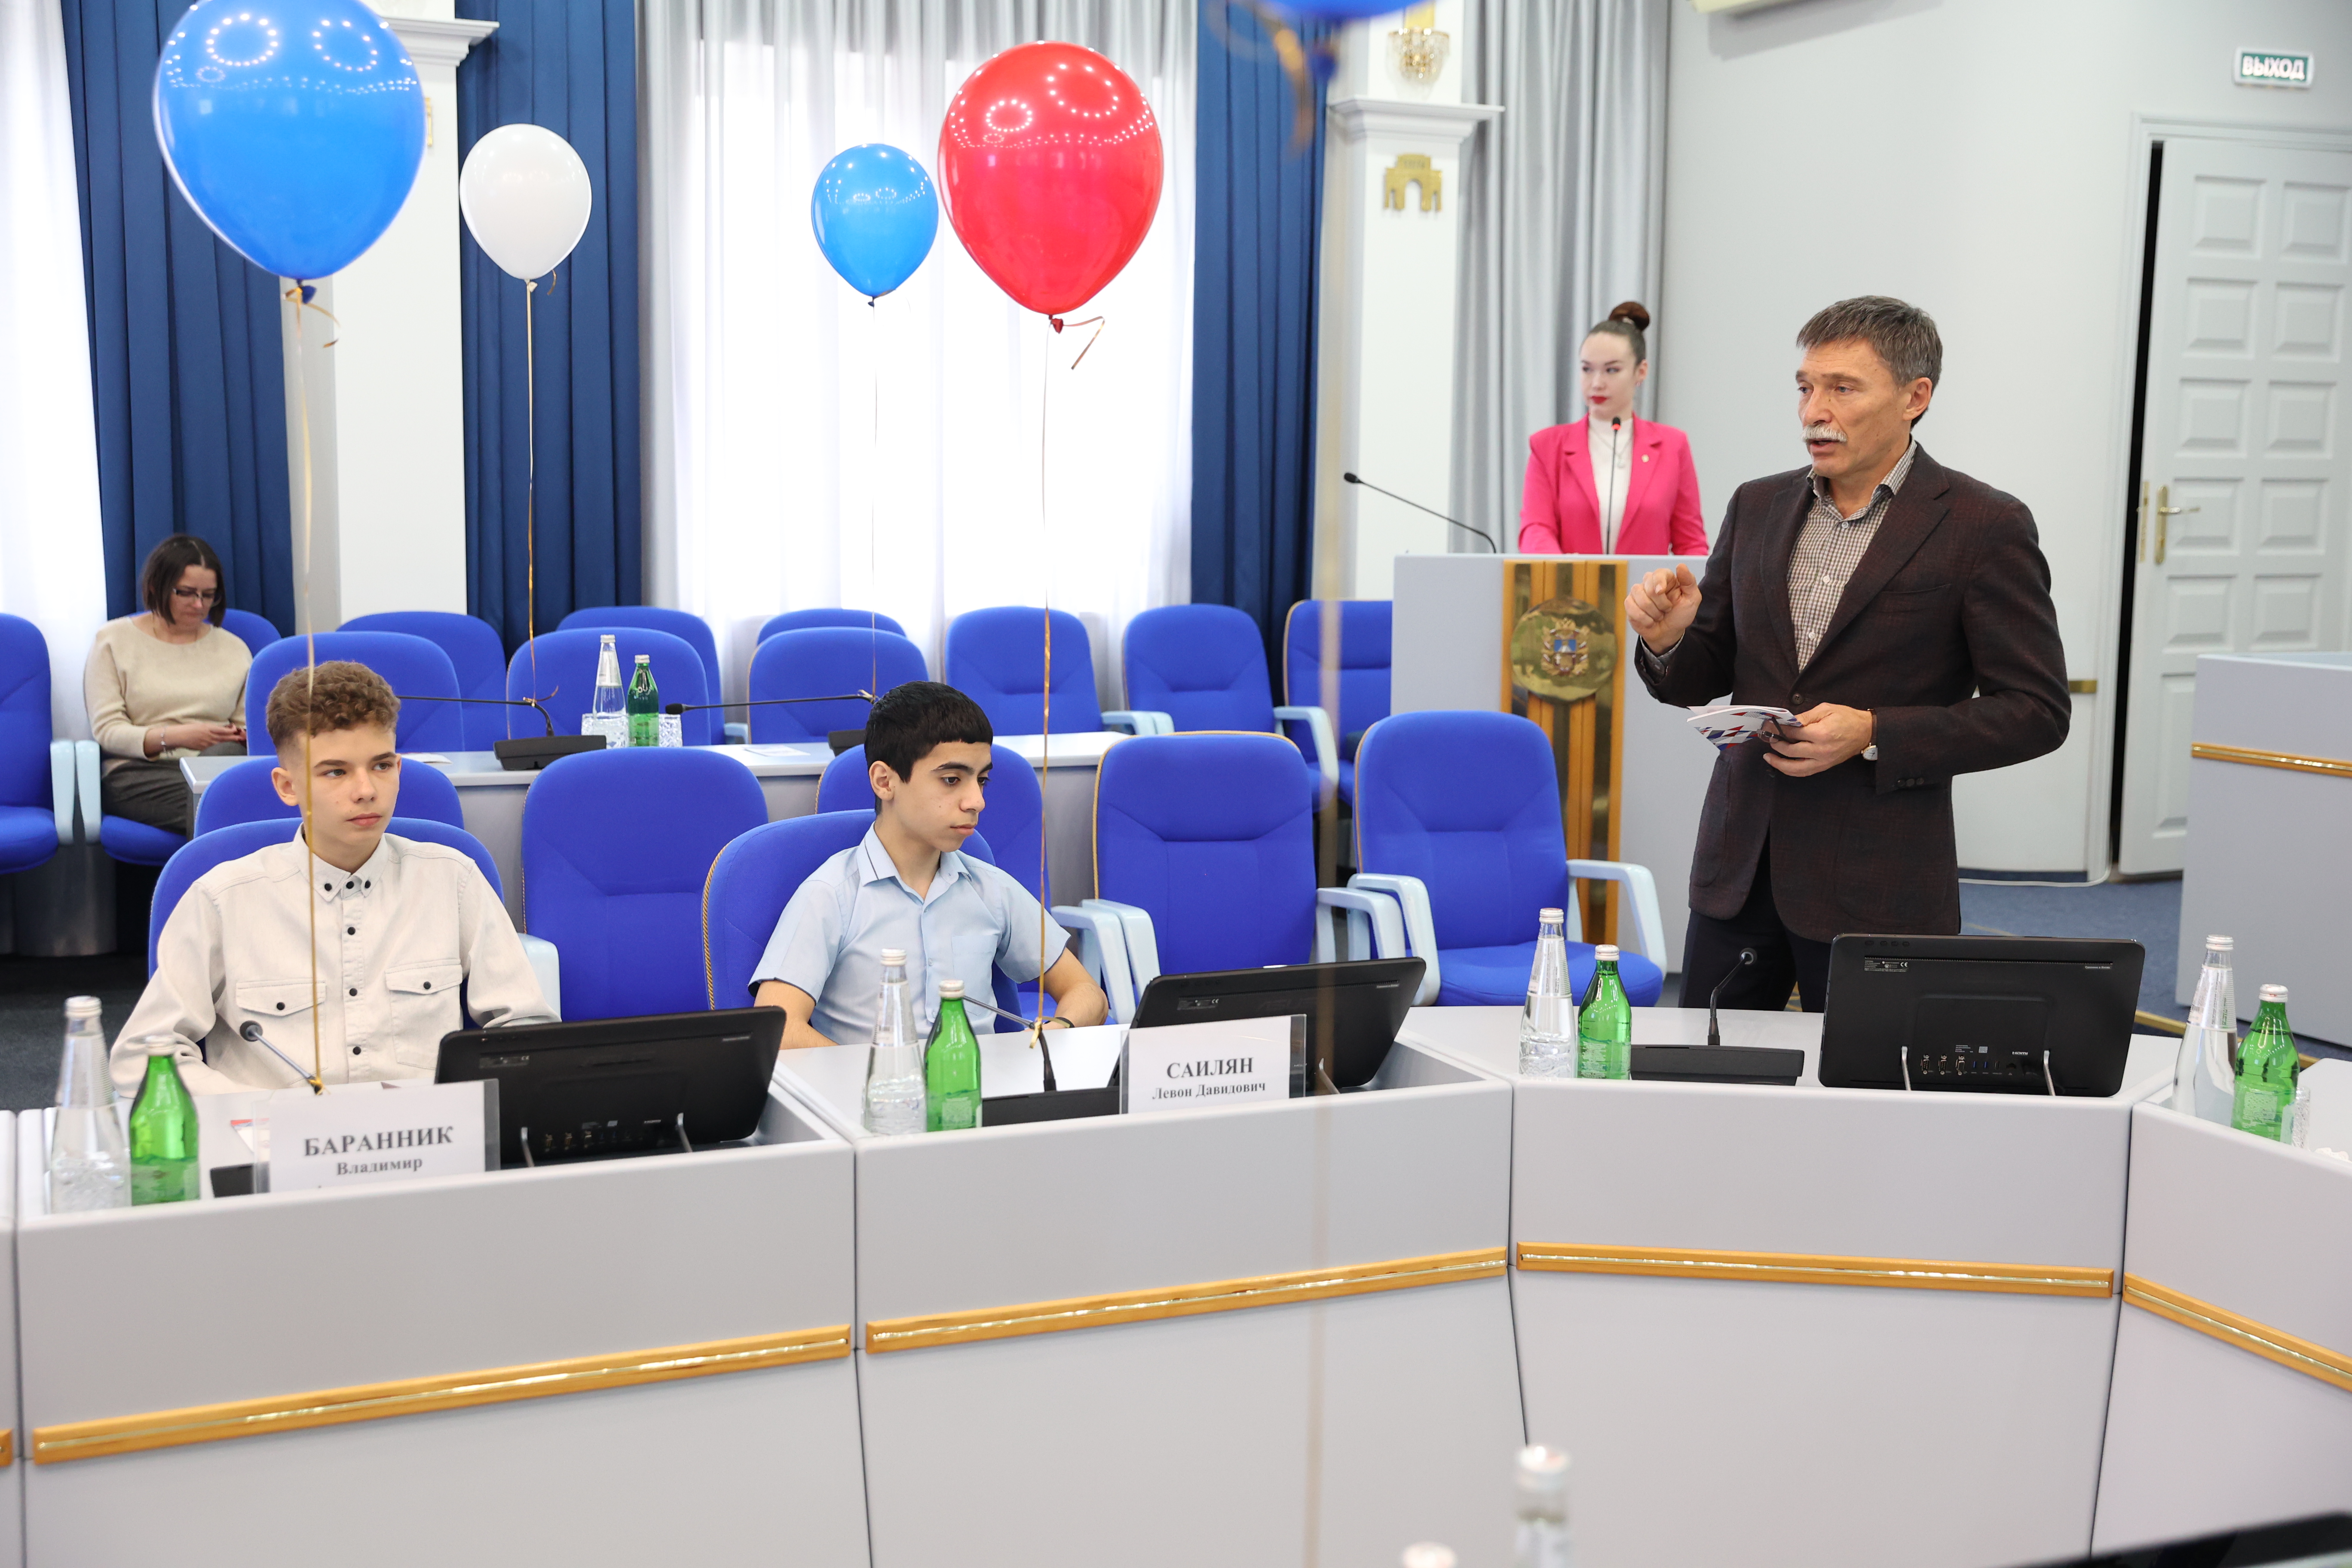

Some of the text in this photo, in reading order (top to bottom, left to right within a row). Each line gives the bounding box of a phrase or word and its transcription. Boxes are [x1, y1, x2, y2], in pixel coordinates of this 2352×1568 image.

[2242, 55, 2305, 80] ВЫХОД
[1167, 1057, 1253, 1078] САИЛЯН
[1152, 1082, 1266, 1099] Левон Давидович
[304, 1125, 454, 1157] БАРАННИК
[336, 1158, 423, 1176] Владимир
